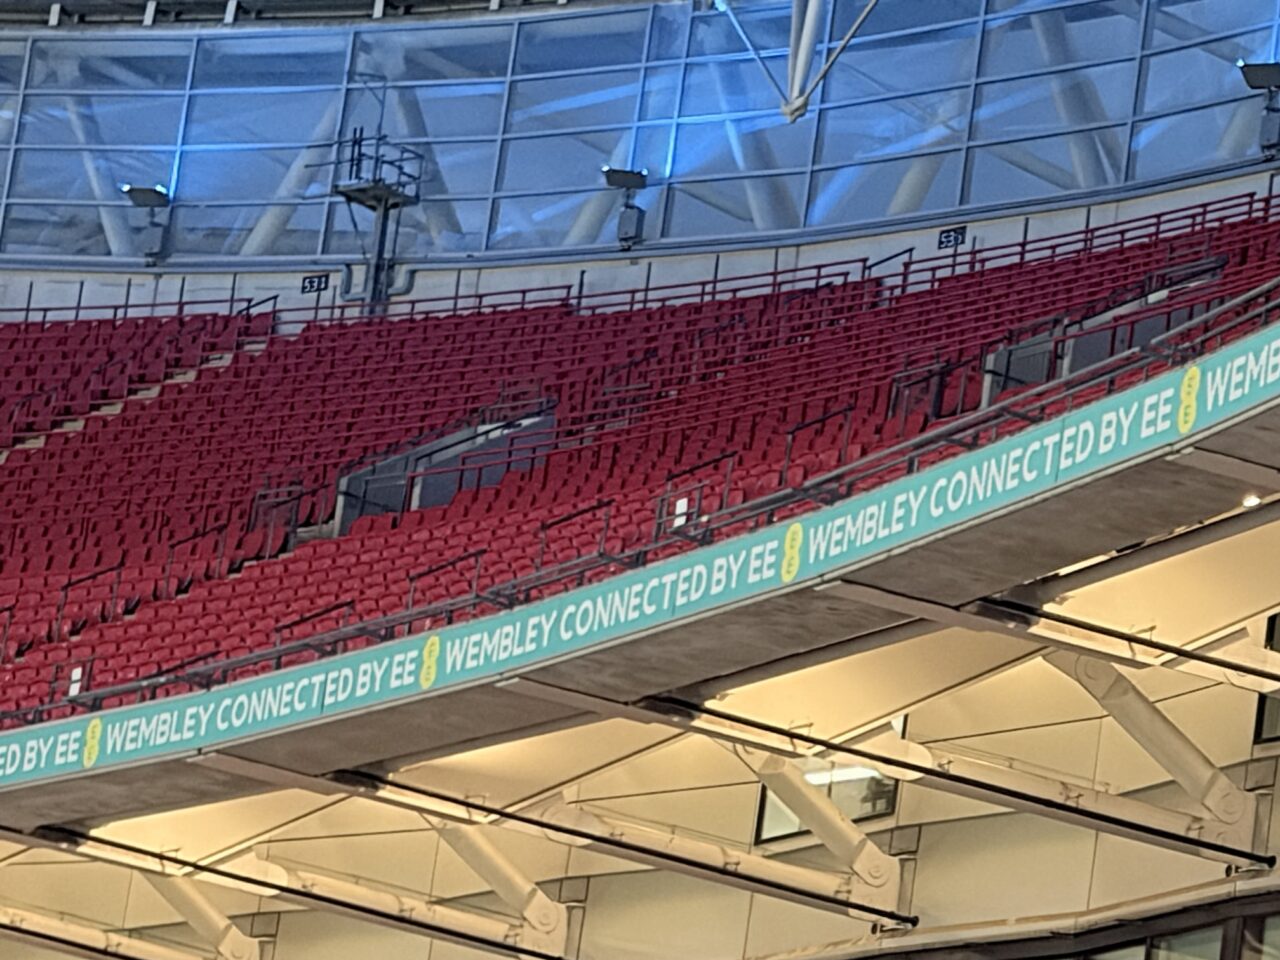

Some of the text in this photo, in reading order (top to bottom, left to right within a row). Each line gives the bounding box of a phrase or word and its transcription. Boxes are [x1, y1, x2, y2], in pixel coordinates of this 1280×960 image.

[808, 485, 928, 565] WEMBLEY
[929, 420, 1095, 518] CONNECTED
[1098, 401, 1138, 455] BY
[1140, 387, 1175, 440] EE
[446, 610, 557, 675] WEMBLEY
[559, 564, 707, 641] CONNECTED
[710, 550, 748, 596] BY
[747, 539, 779, 584] EE
[22, 736, 55, 772] BY
[54, 730, 82, 765] EE
[106, 703, 216, 755] WEMBLEY
[216, 667, 354, 732] CONNECTED
[355, 657, 390, 697] BY
[389, 650, 419, 689] EE
